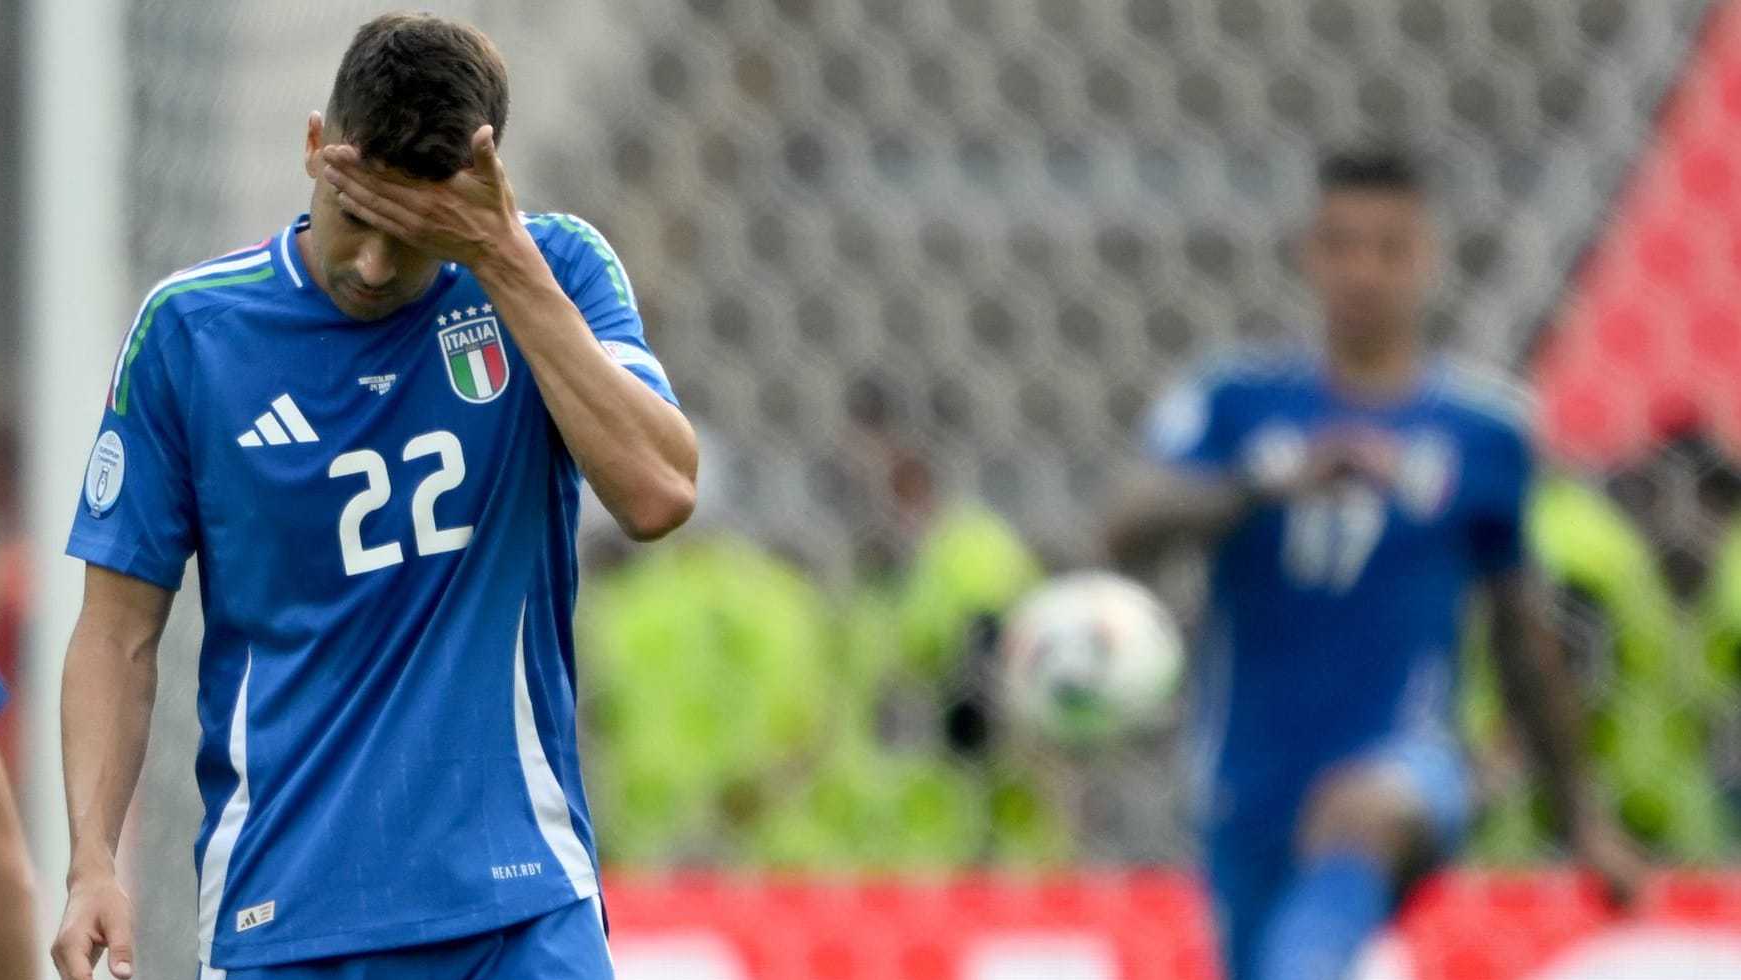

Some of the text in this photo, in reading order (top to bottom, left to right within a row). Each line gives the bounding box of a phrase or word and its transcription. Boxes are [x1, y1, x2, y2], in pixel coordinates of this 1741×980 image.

[443, 323, 495, 351] ITALIA
[328, 430, 475, 577] 22
[491, 862, 542, 880] HEAT.RDY
